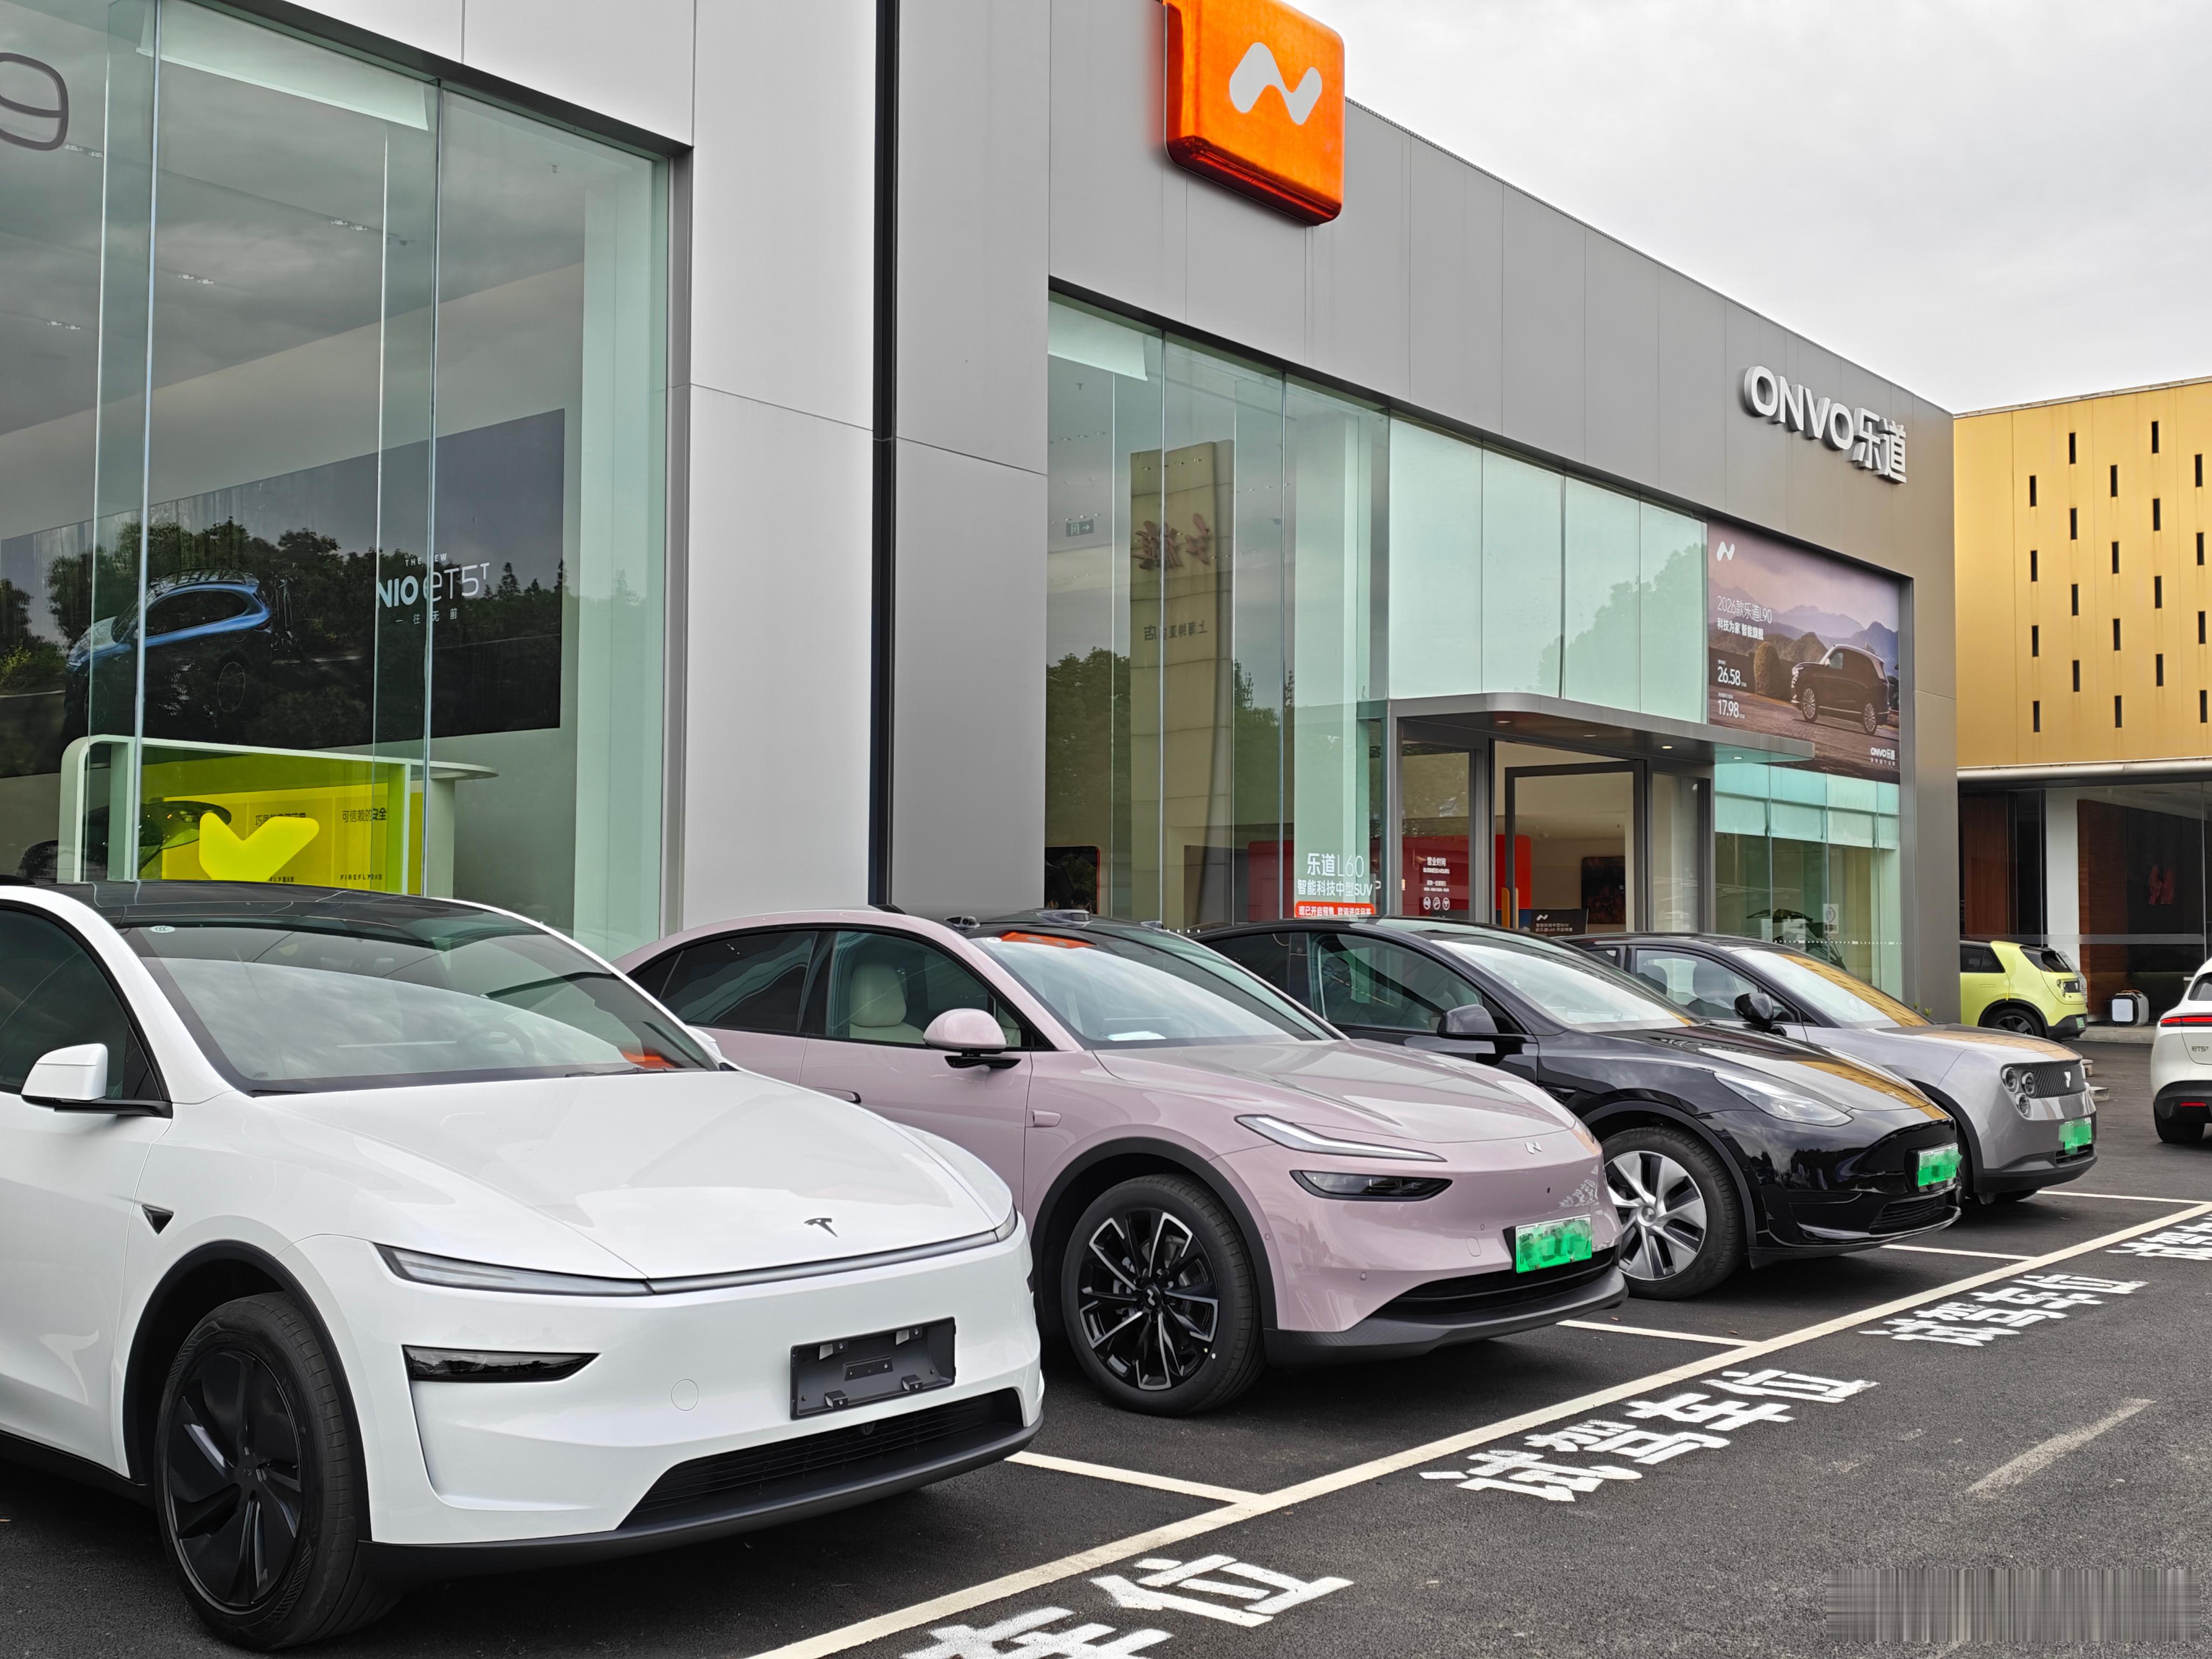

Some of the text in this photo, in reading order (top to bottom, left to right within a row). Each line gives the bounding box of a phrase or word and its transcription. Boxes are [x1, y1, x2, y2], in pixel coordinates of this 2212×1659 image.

[405, 557, 422, 567] THE
[377, 575, 419, 608] NIO
[1717, 595, 1772, 624] 2026款乐道L90
[1718, 666, 1741, 686] 26.58
[1718, 699, 1739, 718] 17.98
[1307, 853, 1364, 878] 乐道L60
[1297, 879, 1373, 897] 智能科技中型SUV
[1858, 1274, 2149, 1347] 试驾车位
[1419, 1369, 1880, 1502] 试驾车位
